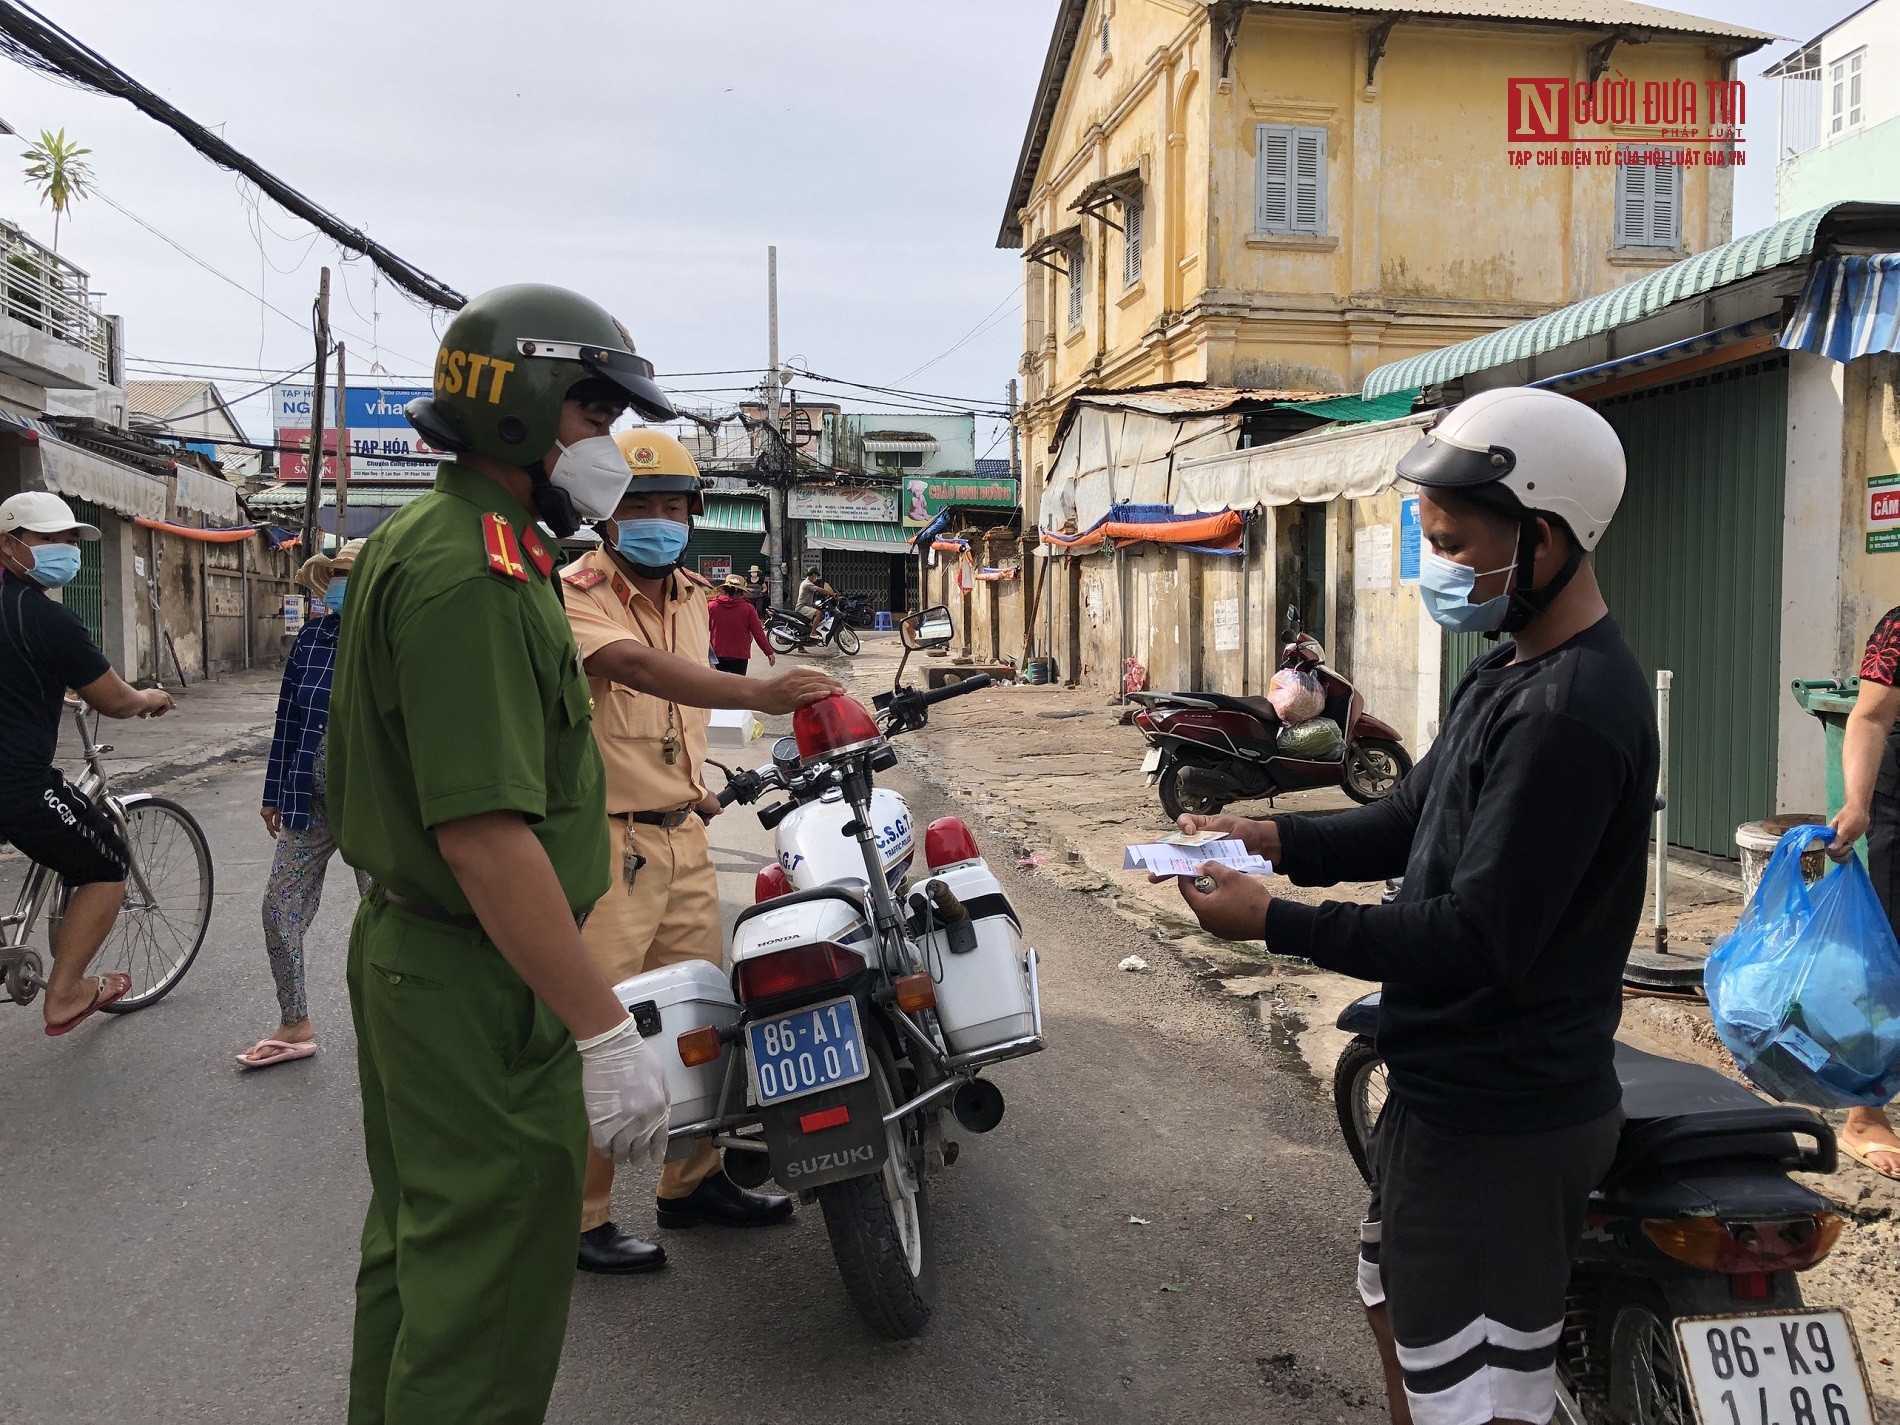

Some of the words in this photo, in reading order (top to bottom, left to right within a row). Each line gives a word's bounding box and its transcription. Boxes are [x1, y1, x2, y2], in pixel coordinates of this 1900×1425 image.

[434, 348, 515, 404] CSTT
[384, 438, 409, 455] HÓA
[757, 934, 801, 948] HONDA
[764, 1005, 842, 1057] 86-A1
[760, 1039, 860, 1097] 000.01
[786, 1144, 875, 1179] SUZUKI
[1706, 1321, 1836, 1381] 86-K9
